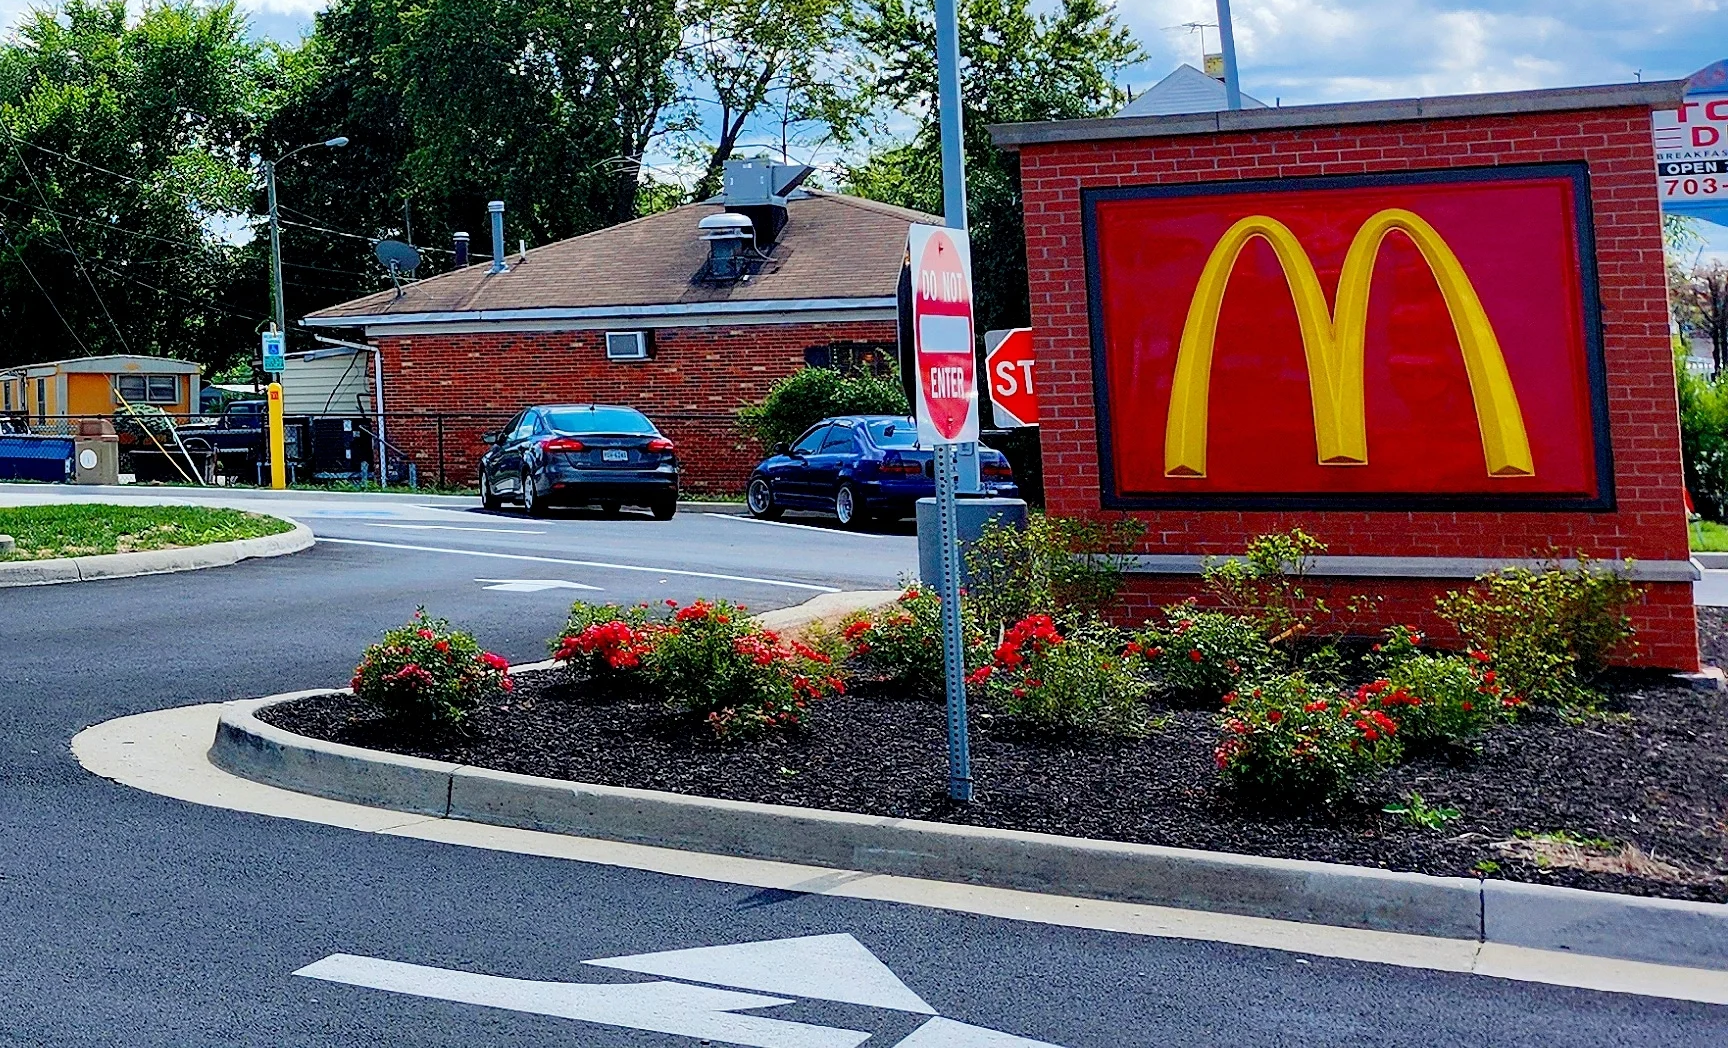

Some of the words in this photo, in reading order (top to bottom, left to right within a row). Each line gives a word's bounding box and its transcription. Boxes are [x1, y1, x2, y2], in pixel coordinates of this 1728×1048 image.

[1667, 162, 1717, 174] OPEN
[922, 269, 937, 301] DO
[943, 272, 963, 303] NOT
[930, 367, 965, 399] ENTER
[996, 360, 1035, 397] ST
